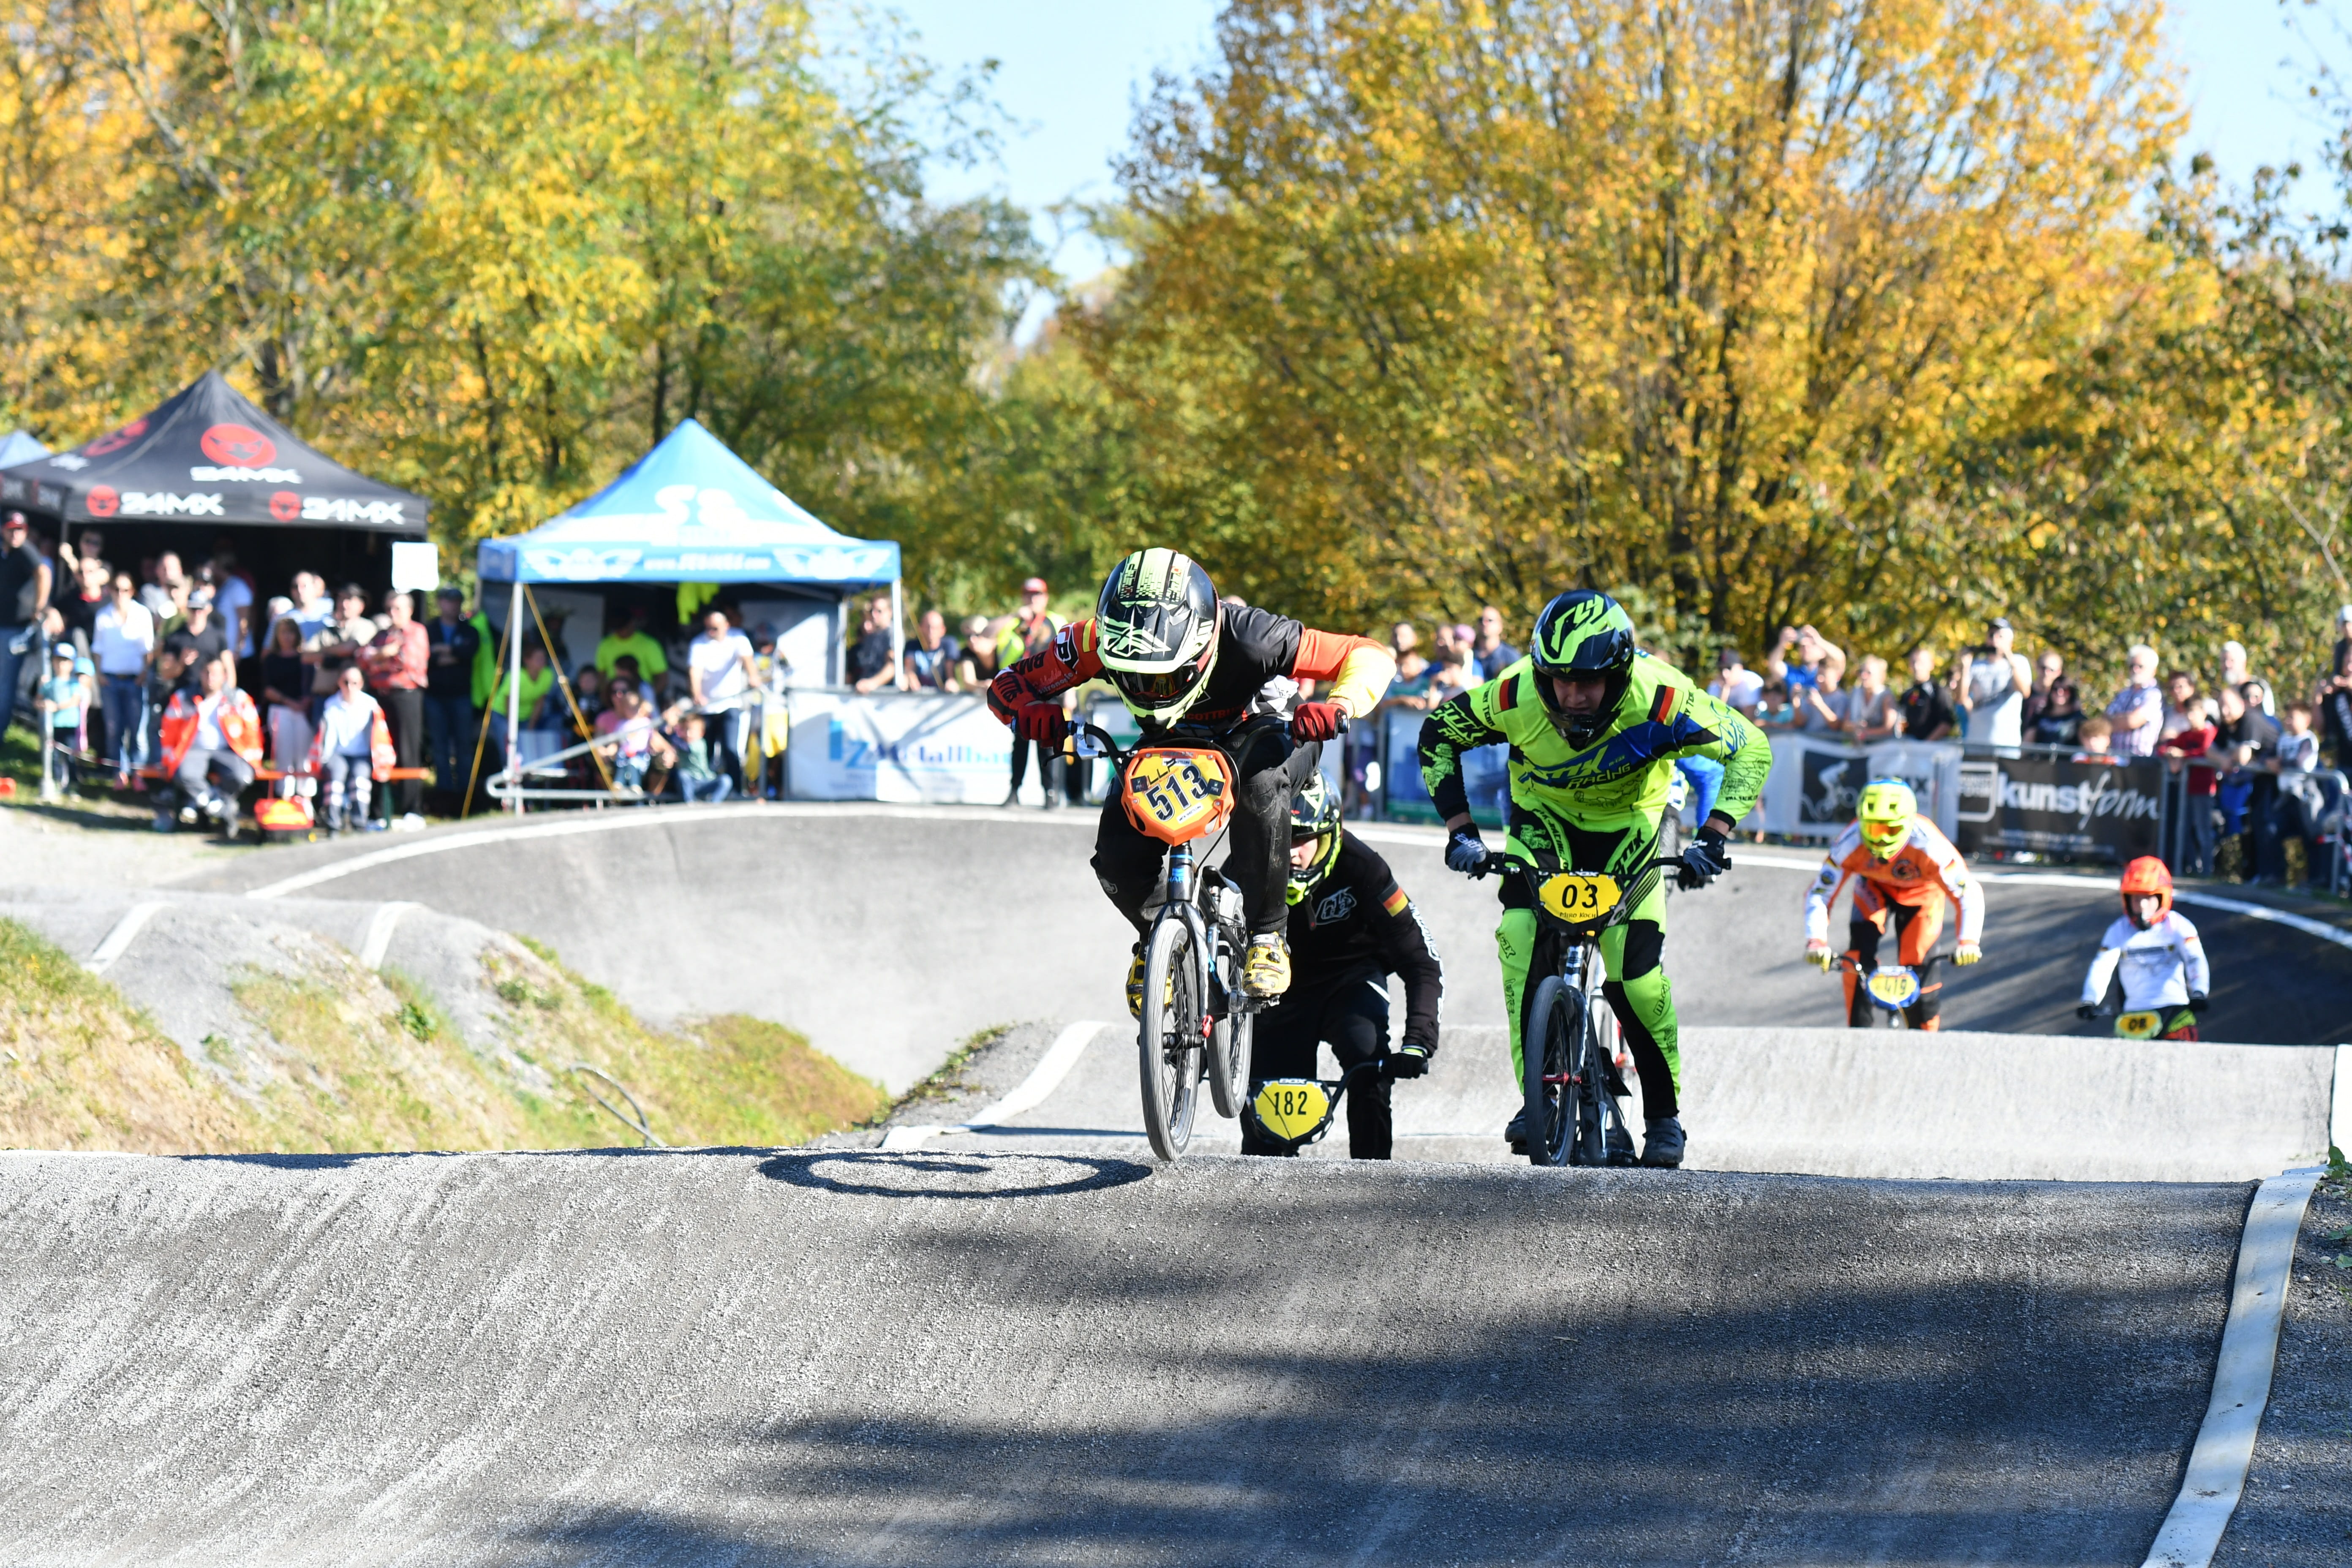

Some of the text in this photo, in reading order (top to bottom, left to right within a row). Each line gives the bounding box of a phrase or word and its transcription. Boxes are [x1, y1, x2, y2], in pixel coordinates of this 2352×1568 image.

[120, 492, 226, 515] 24MX
[1551, 594, 1604, 653] FLY
[1565, 762, 1631, 789] RACING
[1145, 765, 1209, 821] 513
[1997, 770, 2159, 830] kunstform
[1454, 833, 1484, 852] faith
[1562, 884, 1598, 909] 03
[1274, 1091, 1308, 1116] 182
